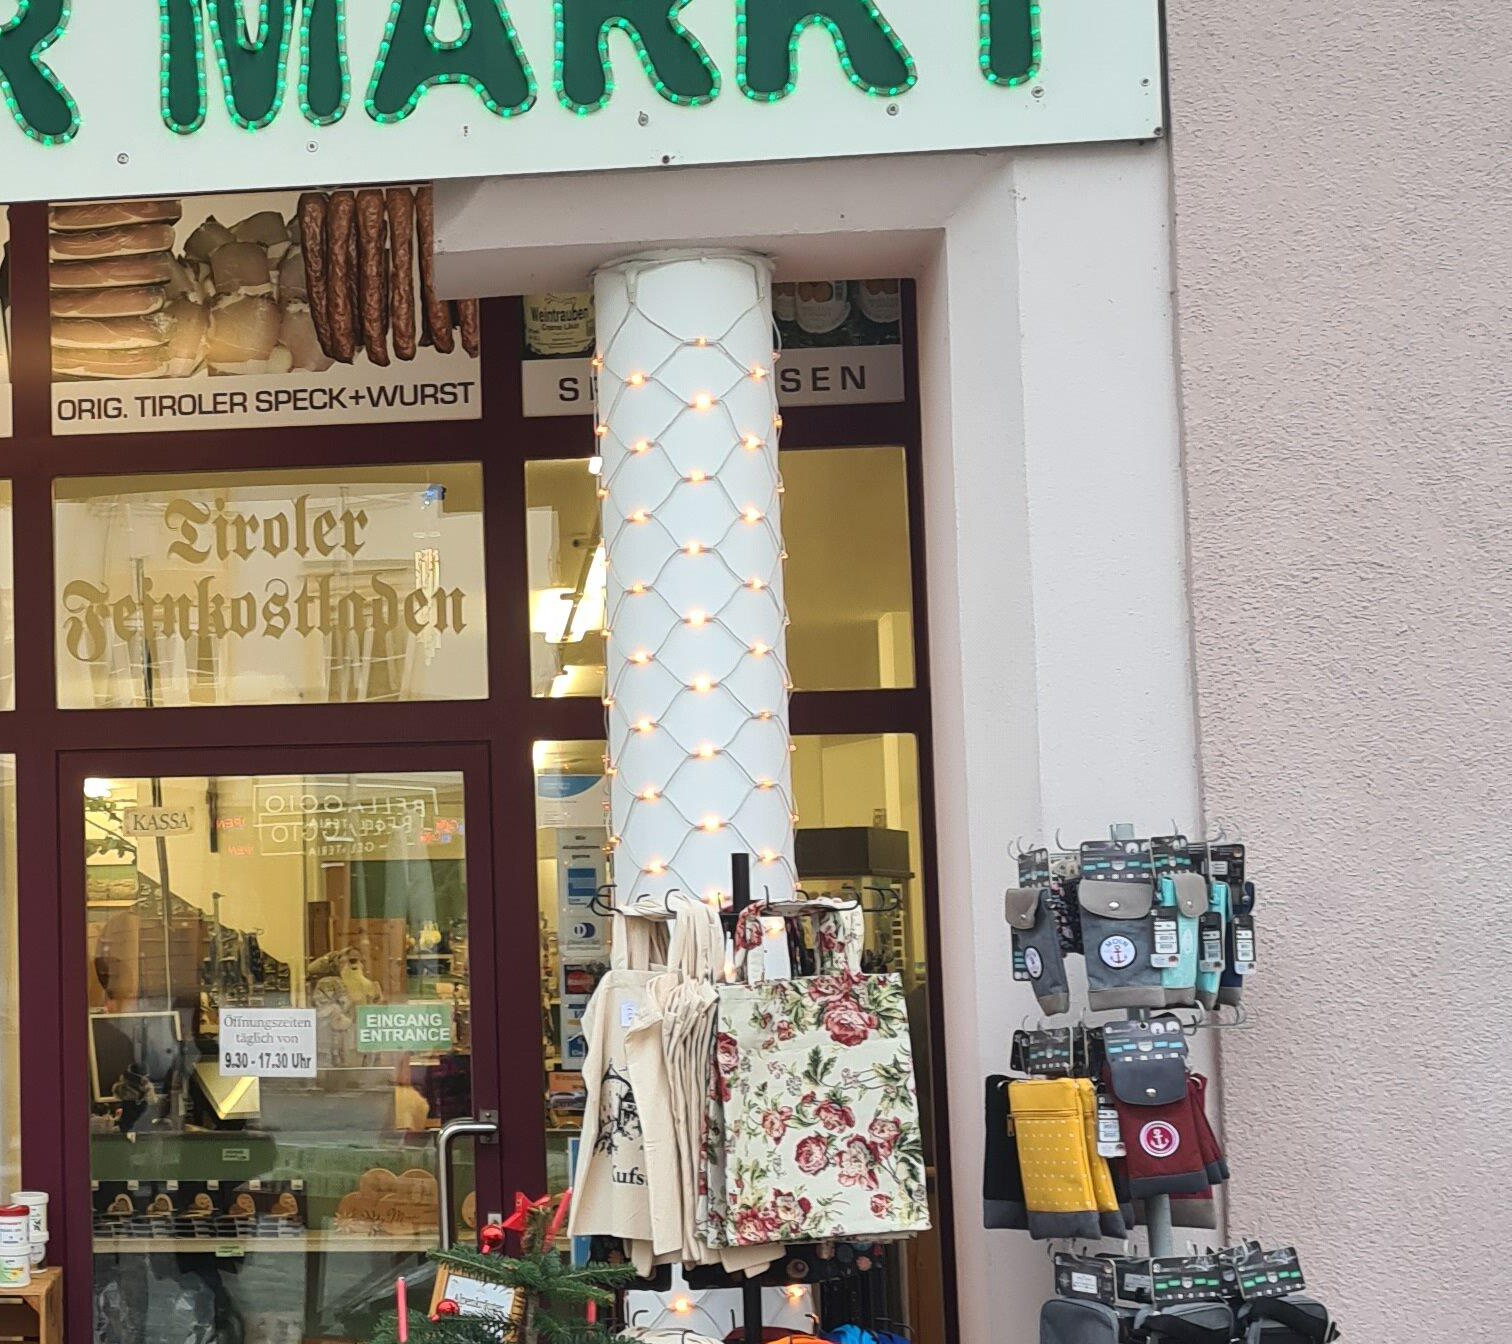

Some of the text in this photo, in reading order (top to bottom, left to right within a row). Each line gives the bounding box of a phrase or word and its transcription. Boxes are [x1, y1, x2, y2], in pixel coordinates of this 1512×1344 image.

[57, 381, 475, 422] ORIG. TIROLER SPECK+WURST
[165, 494, 370, 563] Tiroler
[62, 573, 467, 663] Feinkostladen
[132, 812, 189, 832] KASSA
[224, 1014, 312, 1031] Öffnungszeiten
[366, 1013, 443, 1028] EINGANG
[236, 1033, 299, 1047] täglich von
[359, 1028, 451, 1043] ENTRANCE
[291, 1052, 312, 1069] Uhr
